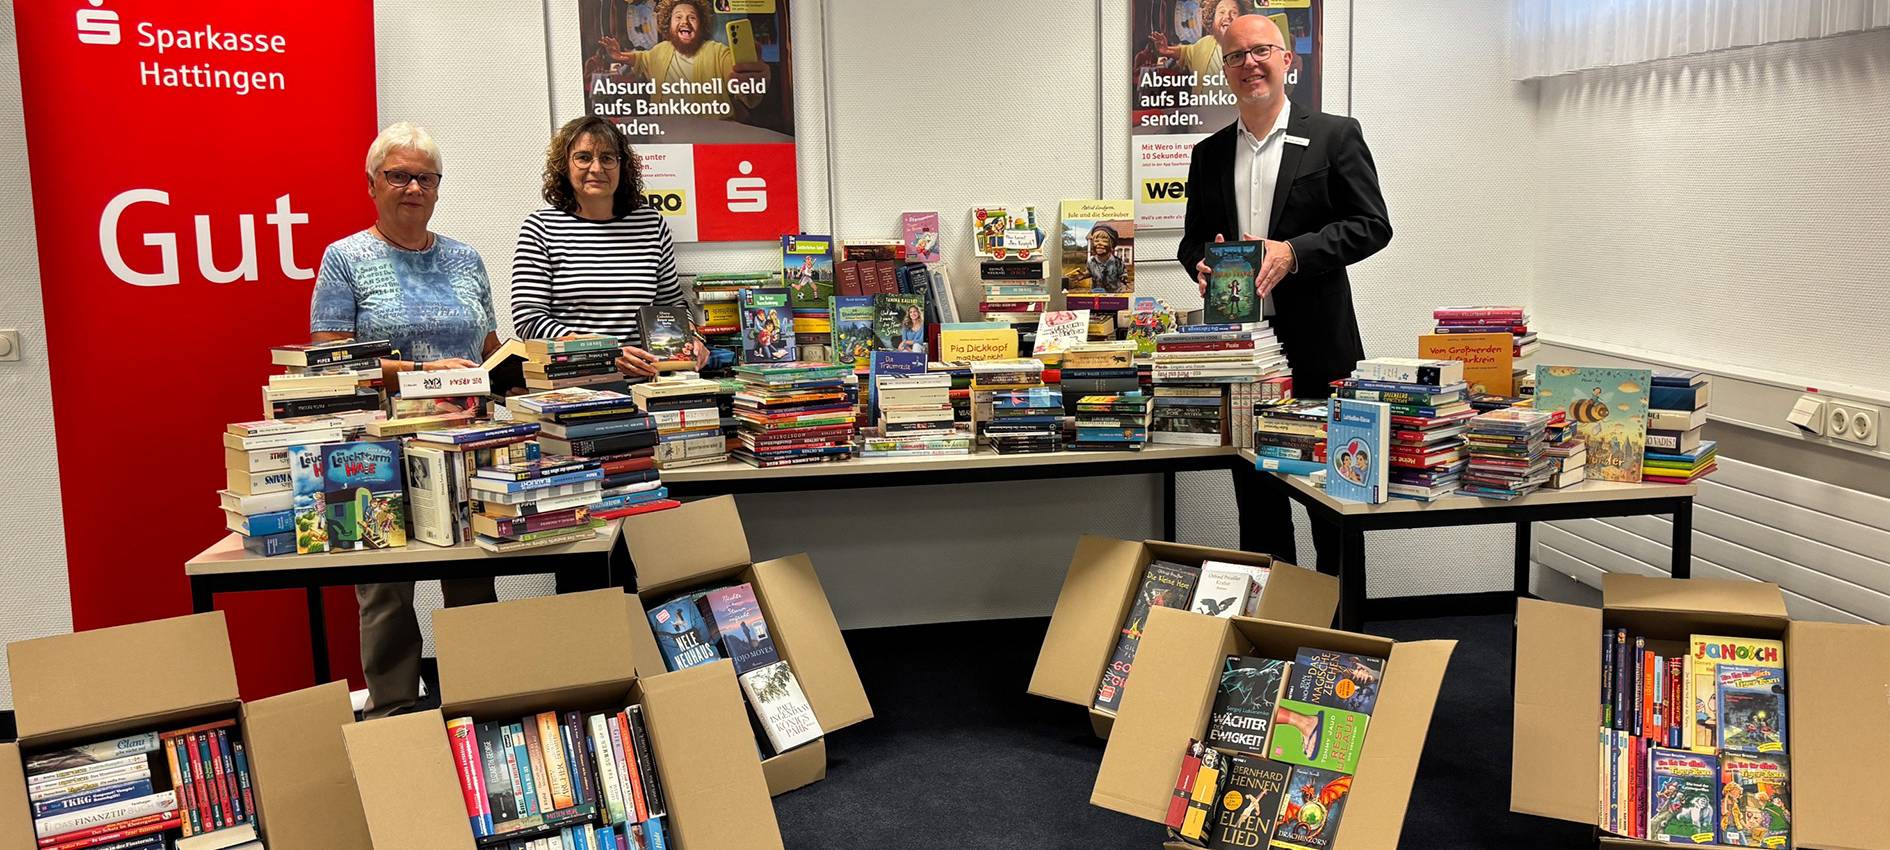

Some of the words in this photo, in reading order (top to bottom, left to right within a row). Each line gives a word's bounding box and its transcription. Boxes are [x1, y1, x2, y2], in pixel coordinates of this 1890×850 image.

[137, 22, 286, 53] Sparkasse
[139, 61, 286, 95] Hattingen
[593, 79, 656, 95] Absurd
[661, 78, 722, 95] schnell
[727, 78, 766, 95] Geld
[1140, 71, 1198, 88] Absurd
[594, 101, 631, 116] aufs
[636, 100, 731, 116] Bankkonto
[1140, 92, 1174, 107] aufs
[616, 119, 665, 135] nden.
[1140, 110, 1203, 127] senden.
[1155, 143, 1174, 151] Wero
[1152, 152, 1190, 160] Sekunden.
[99, 188, 315, 287] Gut
[951, 344, 964, 353] Pia
[966, 342, 1008, 353] Dickkopf
[1448, 345, 1502, 355] Großwerden
[332, 452, 390, 468] Leuchtturm
[1146, 571, 1158, 580] Die
[676, 631, 699, 652] NELE
[674, 643, 714, 670] NEUHAUS
[734, 654, 750, 664] JOJO
[750, 646, 774, 658] MOYES
[1308, 655, 1320, 678] DAS
[1323, 653, 1340, 697] ZEICHEN
[1312, 652, 1331, 704] MAGISCHE
[1213, 711, 1268, 732] WÄCHTER
[786, 726, 809, 738] PARK
[1209, 728, 1264, 748] EWIGKEIT
[1320, 736, 1332, 764] TOMMY
[1328, 715, 1336, 736] JAUD
[1232, 765, 1284, 782] BERNHARD
[1230, 775, 1281, 793] HENNEN
[62, 794, 92, 809] TKKG
[74, 807, 126, 827] FINANZTIP
[1220, 810, 1270, 834] ELFEN
[1221, 827, 1260, 848] LIED
[1278, 829, 1328, 846] DRACHENZORN
